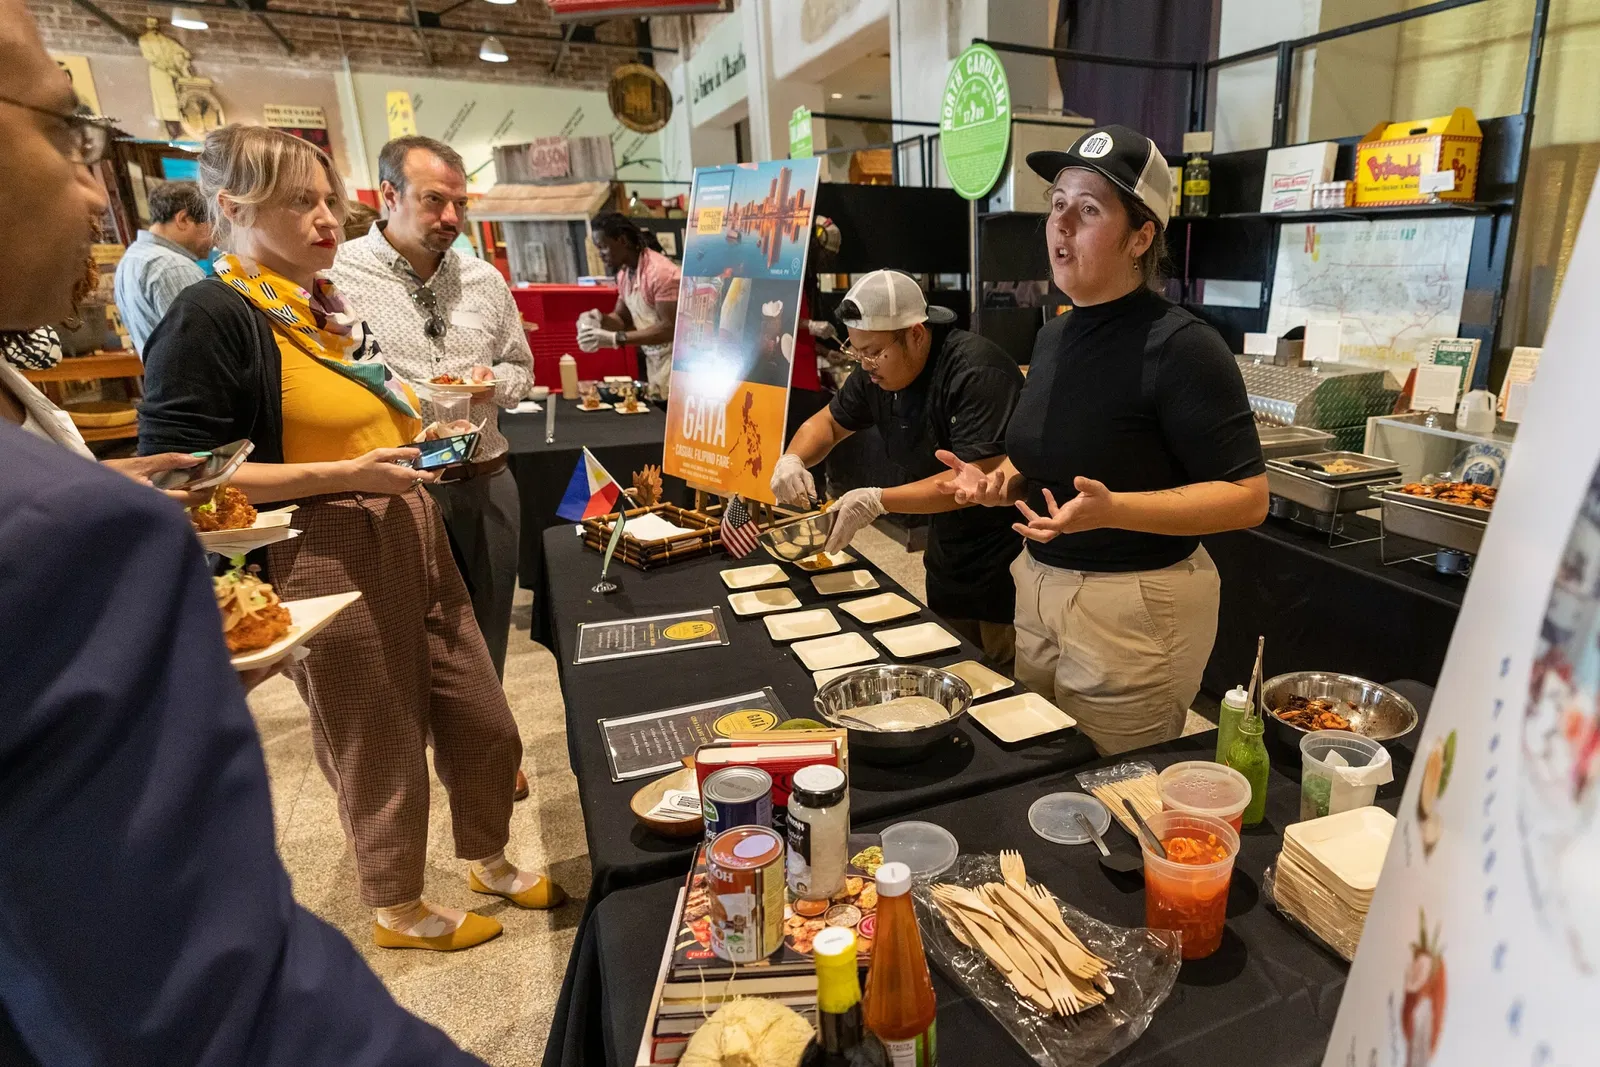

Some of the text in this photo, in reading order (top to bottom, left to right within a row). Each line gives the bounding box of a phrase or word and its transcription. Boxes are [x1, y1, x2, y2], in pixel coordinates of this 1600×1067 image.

[944, 68, 964, 131] NORTH
[966, 52, 1007, 117] CAROLINA
[675, 443, 694, 460] CASUAL
[694, 447, 716, 466] FILIPINO
[716, 453, 730, 469] FARE
